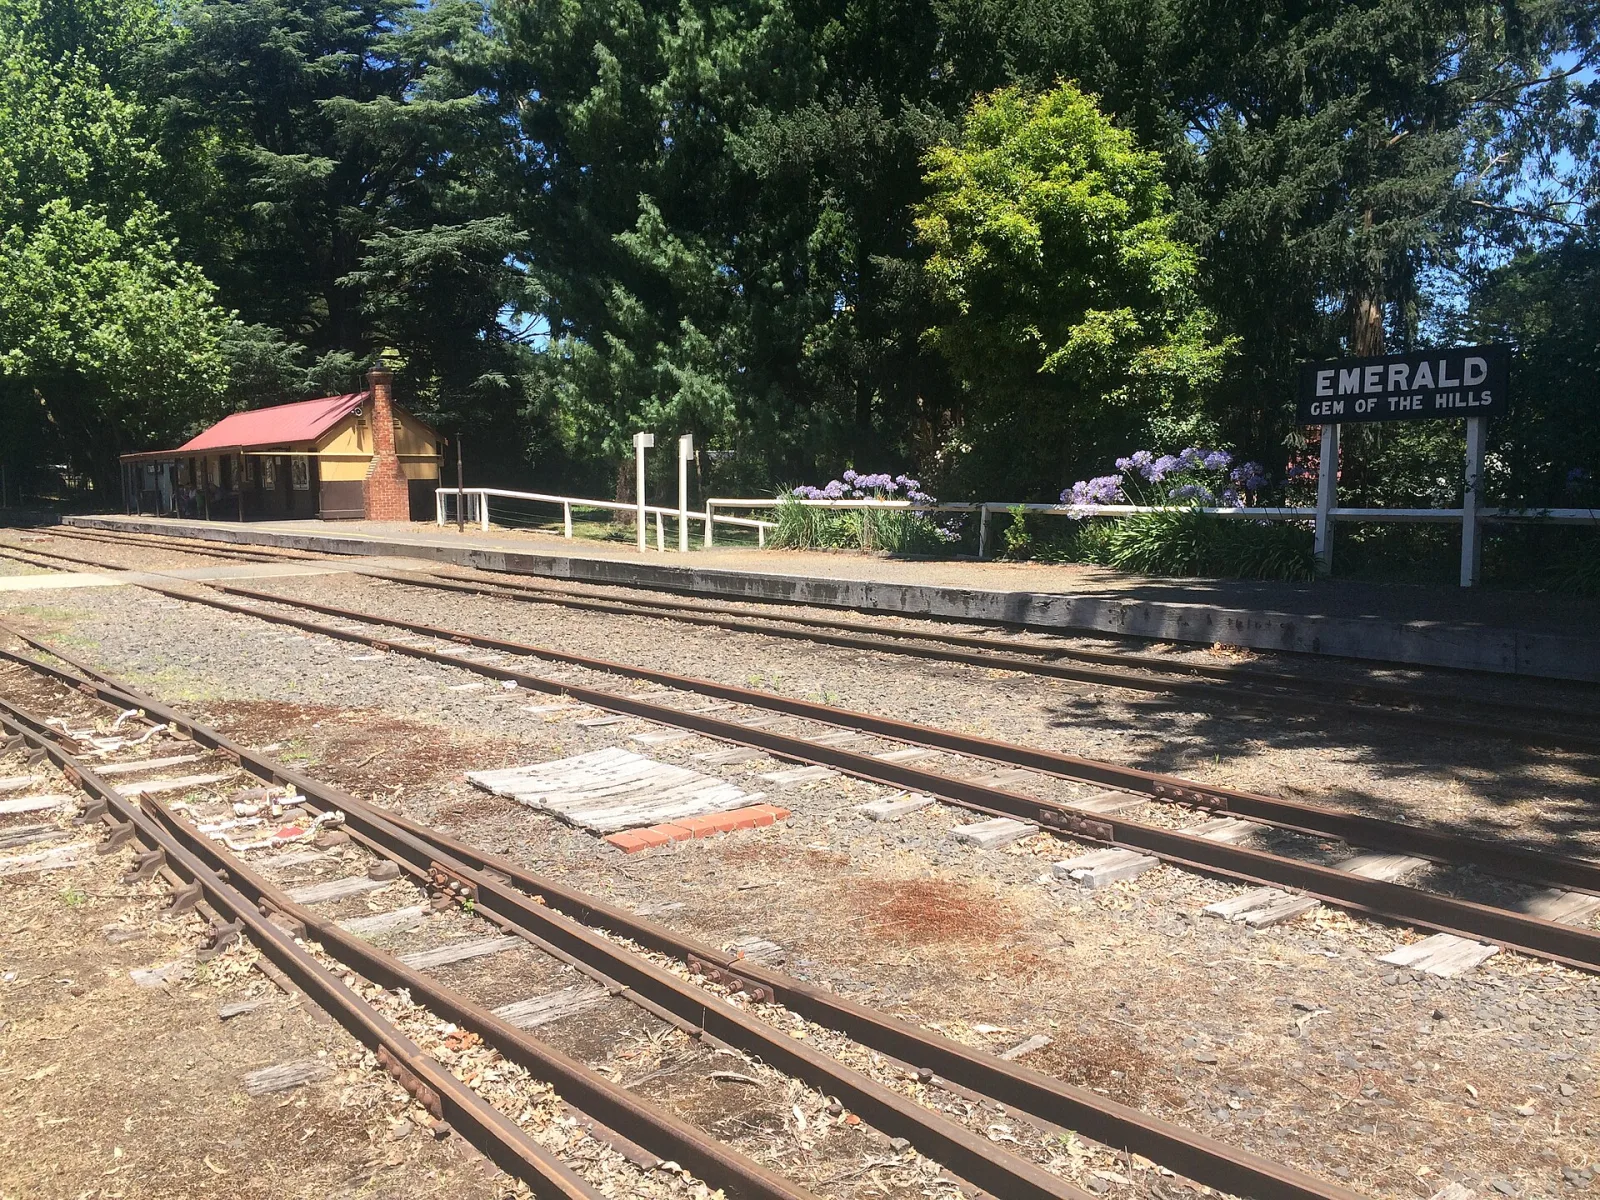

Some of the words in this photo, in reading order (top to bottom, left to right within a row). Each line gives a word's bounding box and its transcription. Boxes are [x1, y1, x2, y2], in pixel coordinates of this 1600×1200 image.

[1315, 356, 1488, 397] EMERALD
[1310, 400, 1345, 416] GEM
[1354, 398, 1378, 413] OF
[1388, 395, 1423, 411] THE
[1435, 390, 1492, 409] HILLS
